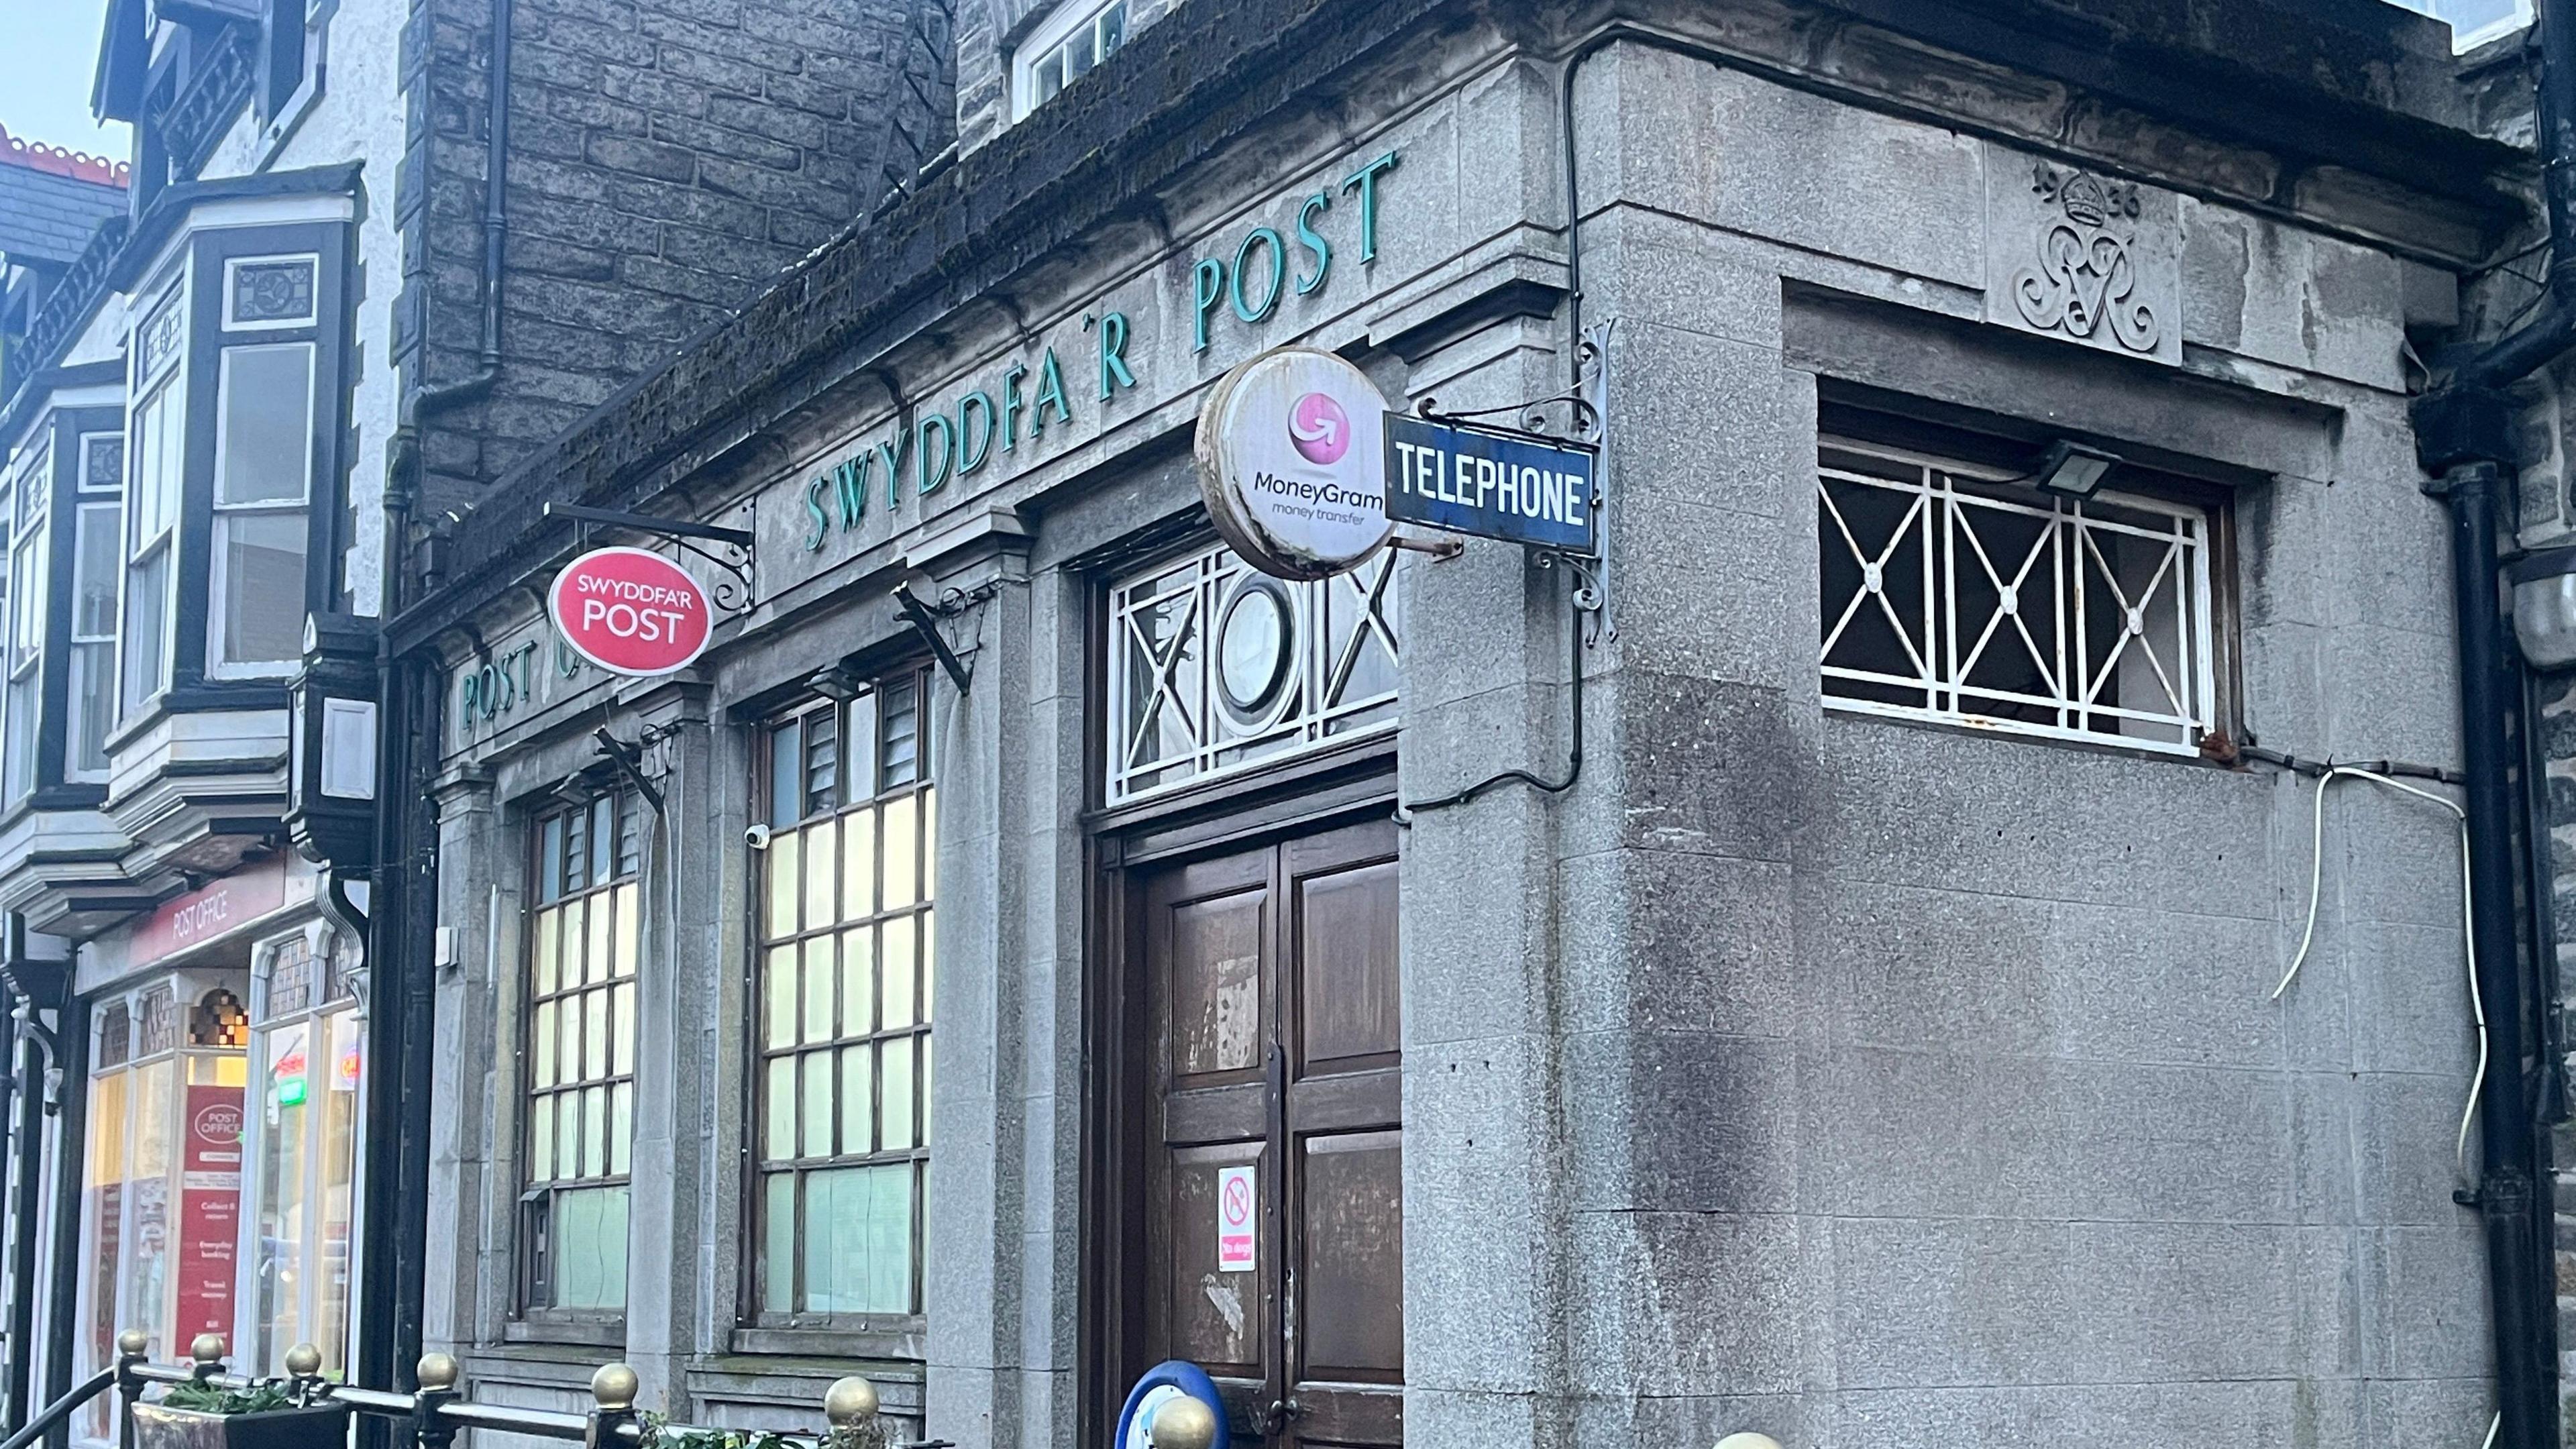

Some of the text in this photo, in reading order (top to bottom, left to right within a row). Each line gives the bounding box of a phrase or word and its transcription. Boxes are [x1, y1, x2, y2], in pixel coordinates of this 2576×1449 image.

[805, 150, 1397, 553] SWYDDFA'R POST
[1254, 471, 1383, 511] MoneyGram
[1395, 441, 1585, 527] TELEPHONE
[1272, 503, 1365, 526] money transfer
[577, 574, 692, 610] SWYDDFA'R
[582, 598, 685, 644] POST
[463, 639, 537, 731] POST
[172, 890, 227, 940] POST OFFICE
[201, 1123, 241, 1134] OFFICE
[208, 1113, 238, 1123] POST
[1222, 1242, 1252, 1258] No dogs
